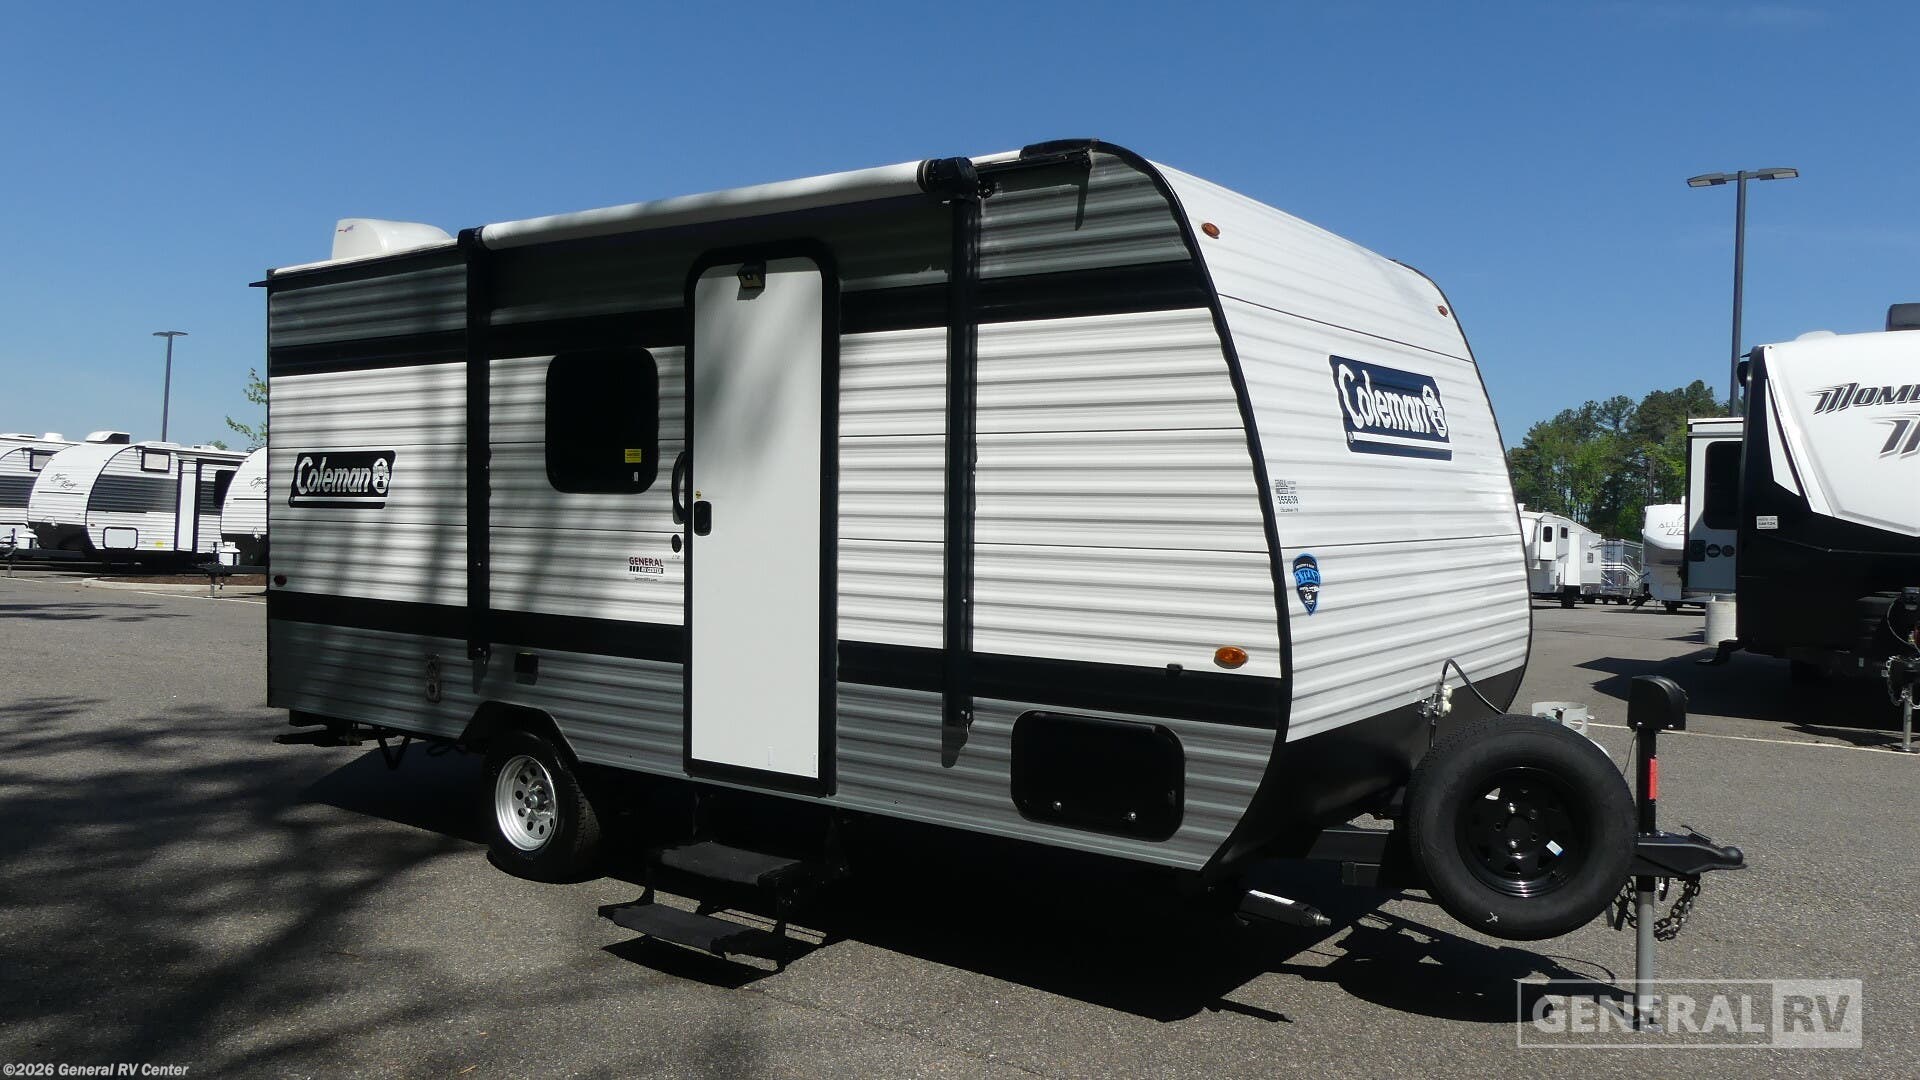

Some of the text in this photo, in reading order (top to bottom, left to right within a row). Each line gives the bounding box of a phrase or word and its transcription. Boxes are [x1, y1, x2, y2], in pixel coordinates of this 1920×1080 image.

[1338, 363, 1431, 434] Coleman
[296, 456, 371, 495] Coleman
[628, 556, 664, 567] GENERAL
